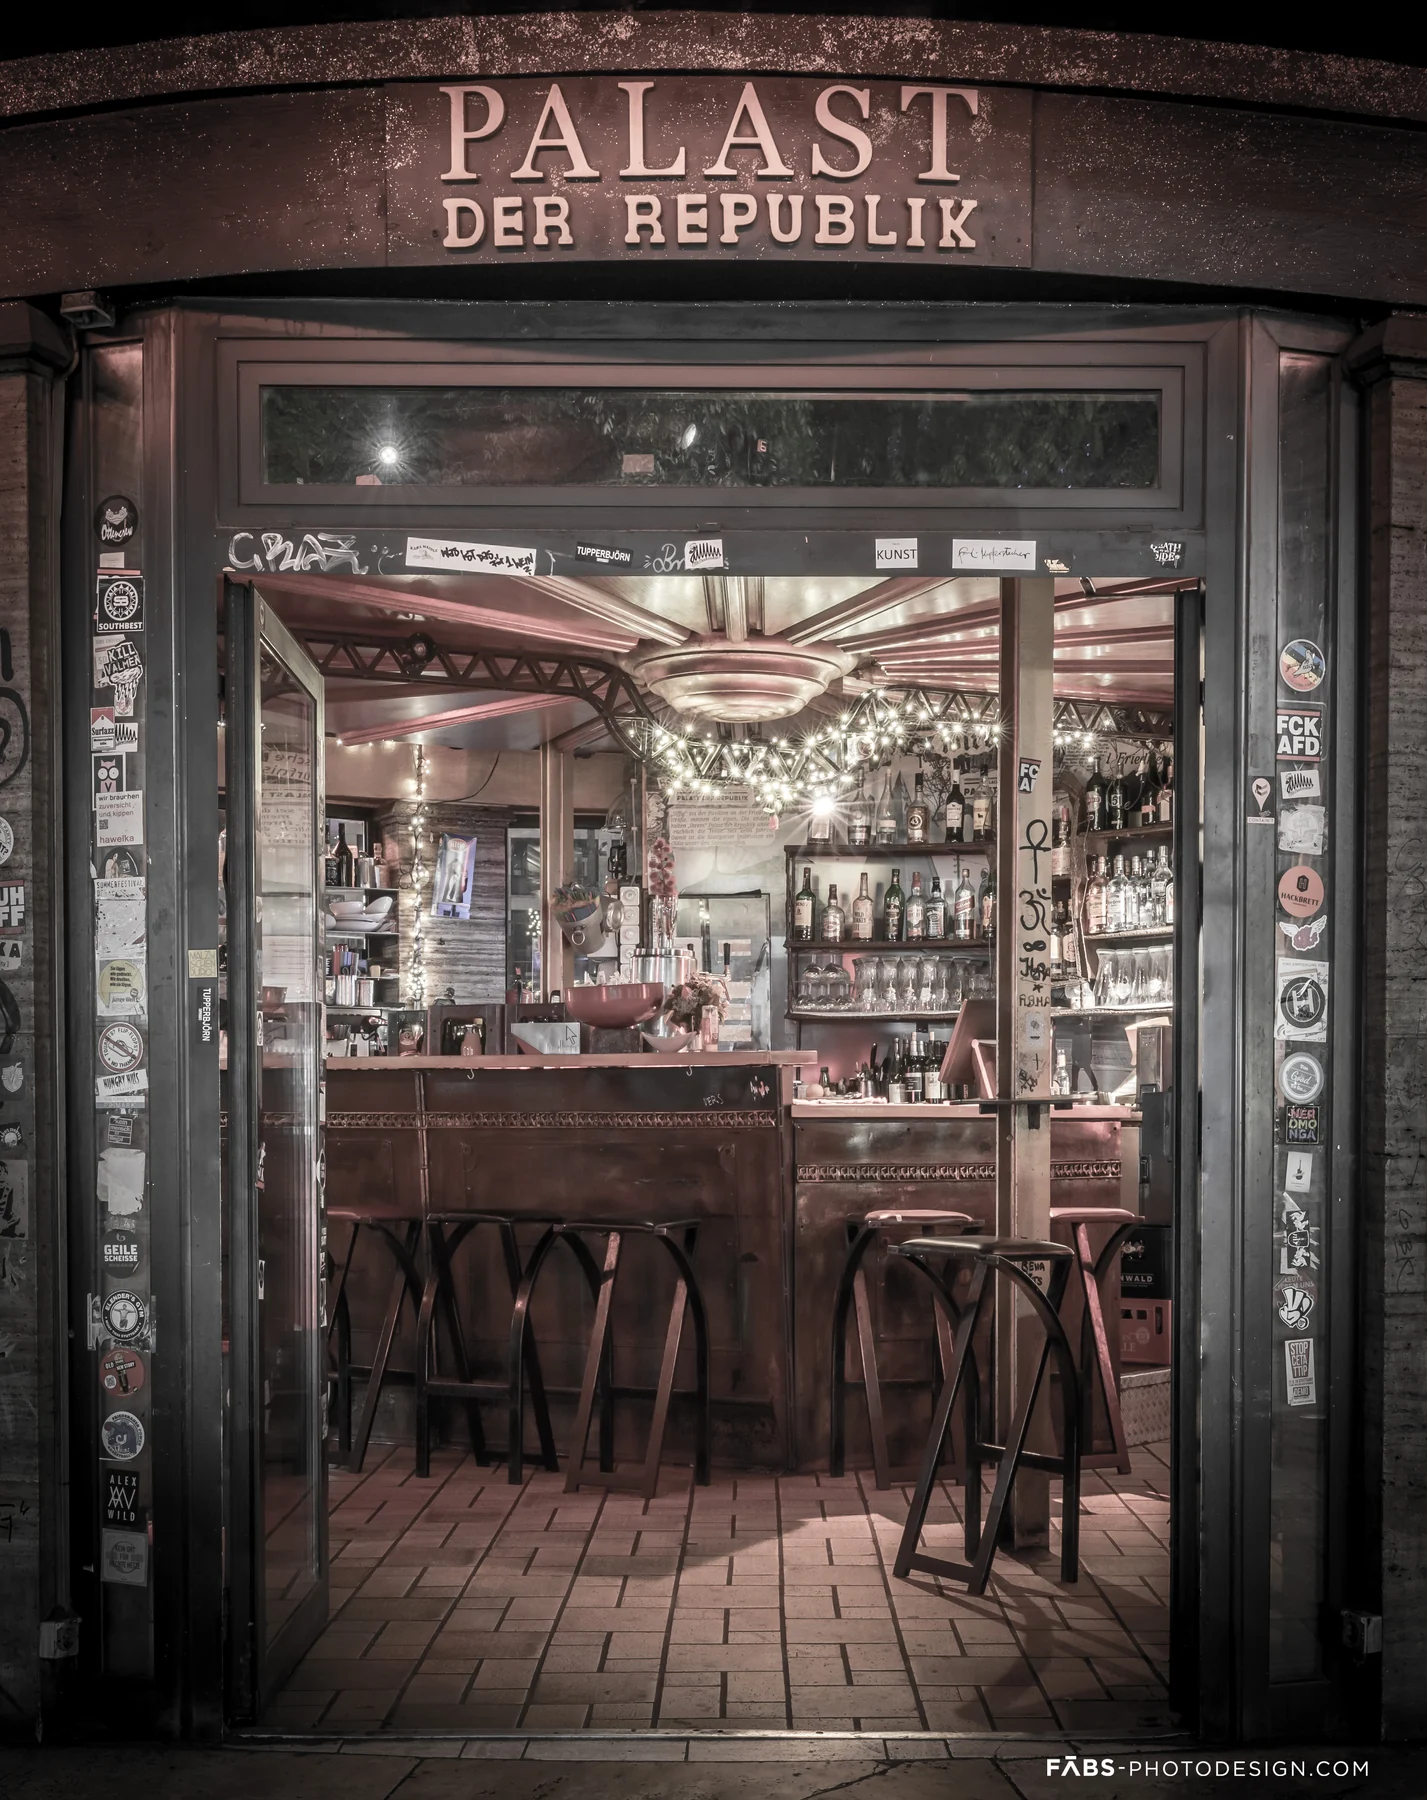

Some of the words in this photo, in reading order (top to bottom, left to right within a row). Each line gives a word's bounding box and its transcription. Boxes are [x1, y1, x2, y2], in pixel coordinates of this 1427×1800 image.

[439, 81, 978, 182] PALAST
[442, 196, 574, 248] DER
[624, 193, 978, 248] REPUBLIK
[577, 546, 632, 563] TUPPERBJÖRN
[877, 549, 917, 560] KUNST
[98, 621, 143, 630] SOUTHBEST
[108, 644, 136, 661] KILL
[1277, 715, 1320, 736] FCK
[1277, 736, 1320, 755] AFD
[99, 801, 132, 809] zuversicht
[112, 810, 134, 818] kippen
[100, 835, 134, 844] hawelka
[1281, 892, 1319, 907] HACKBRETT
[201, 987, 213, 1042] TUPPERBJÖRN
[1289, 1128, 1316, 1140] NGA
[104, 1244, 138, 1255] GEILE
[1290, 1342, 1308, 1355] STOP
[1291, 1354, 1308, 1366] CETA
[1293, 1365, 1308, 1377] TTIP
[110, 1474, 137, 1487] ALEX
[107, 1509, 136, 1522] WILD
